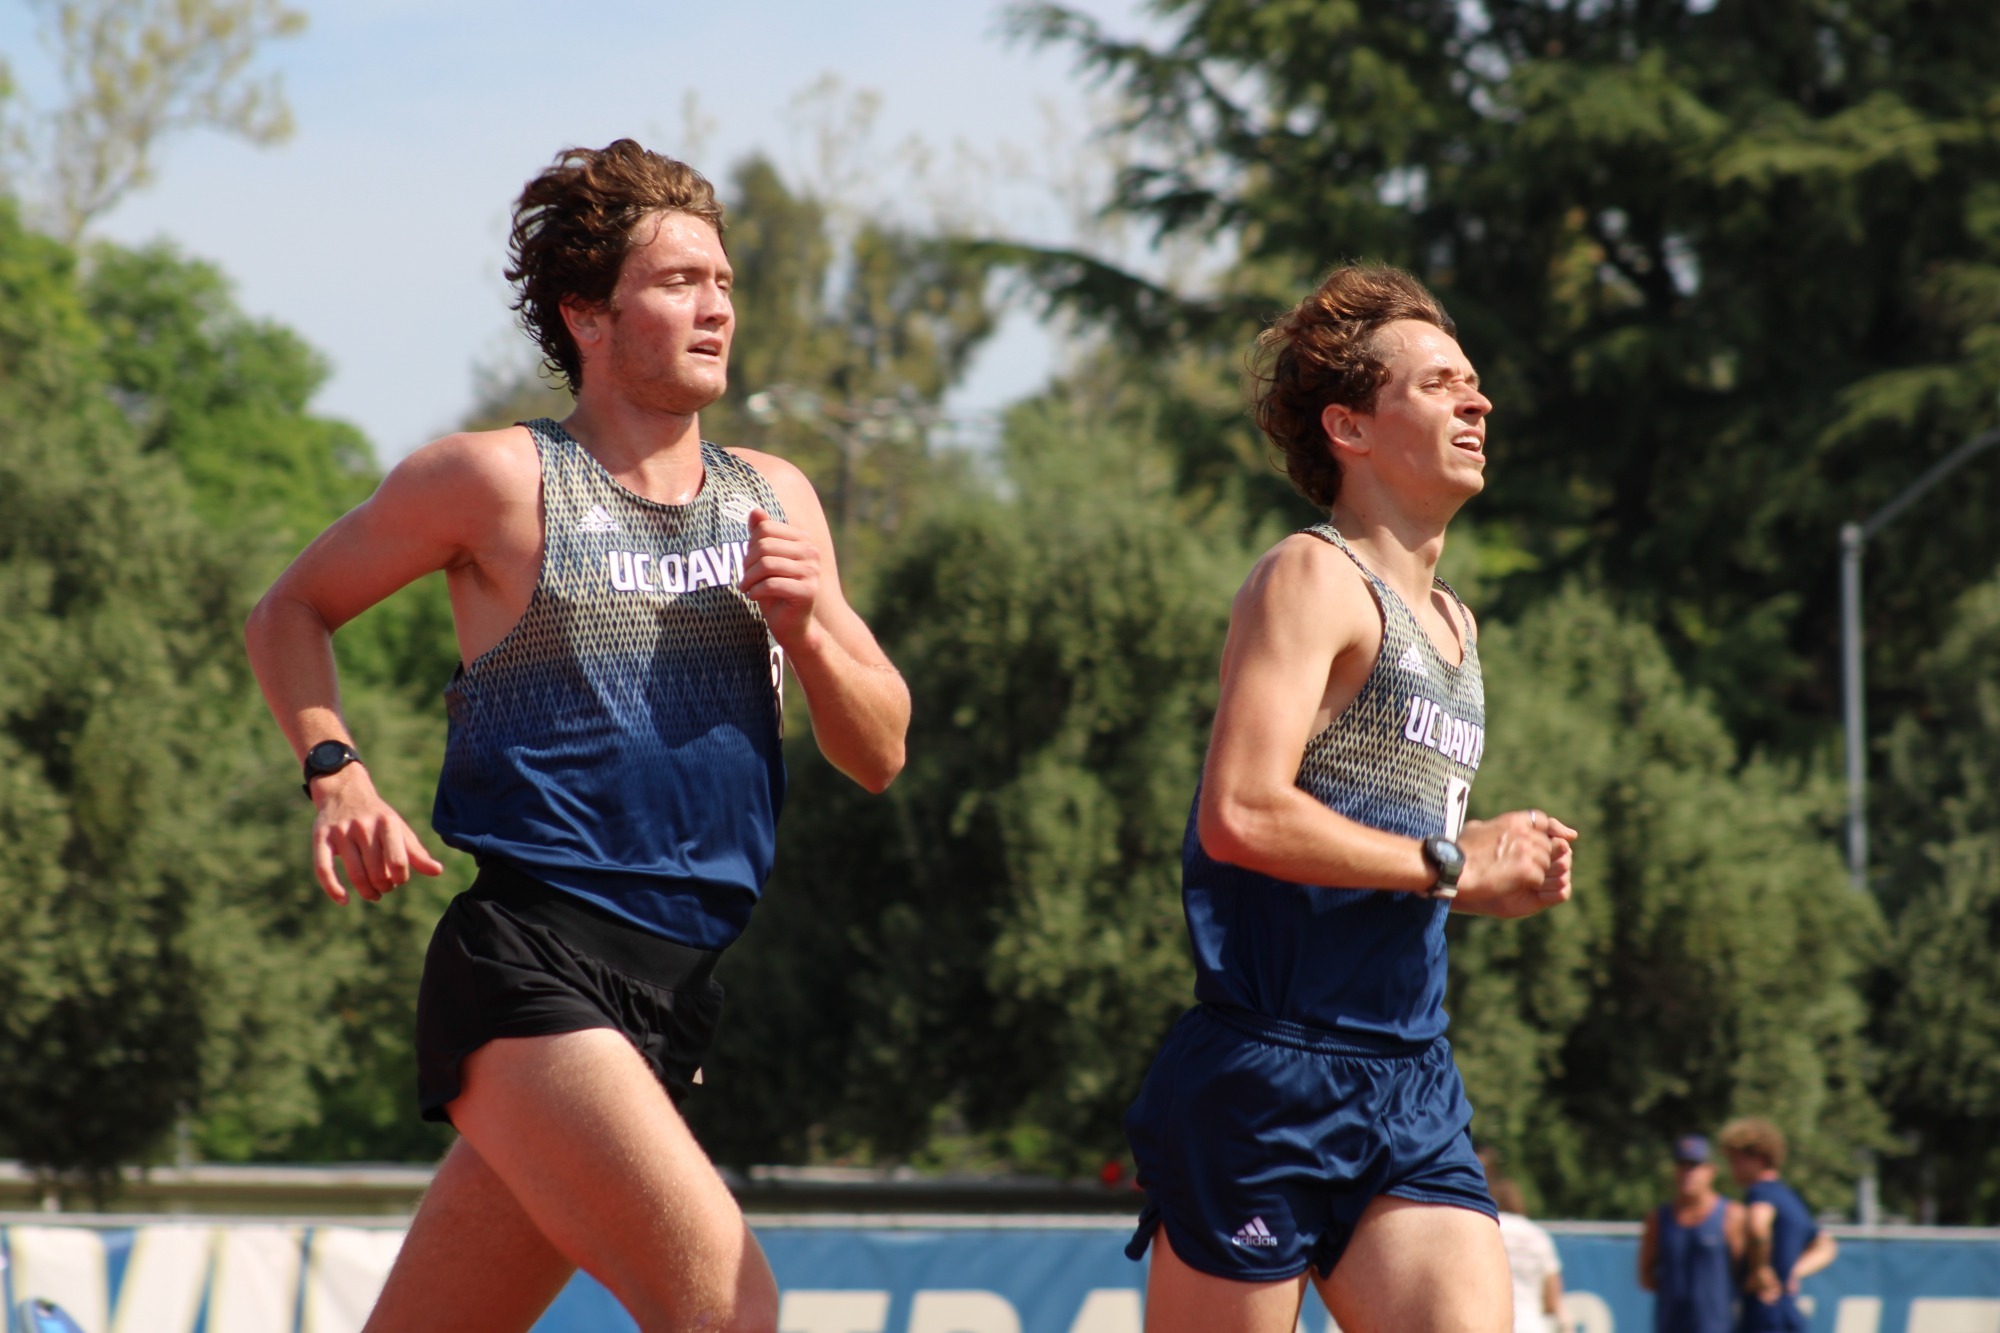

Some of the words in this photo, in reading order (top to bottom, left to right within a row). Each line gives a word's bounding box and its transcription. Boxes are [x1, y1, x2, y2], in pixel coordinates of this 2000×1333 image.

[608, 551, 654, 592] UC
[658, 540, 750, 594] DAVI
[1405, 695, 1440, 748] UC
[1231, 1235, 1278, 1247] adidas
